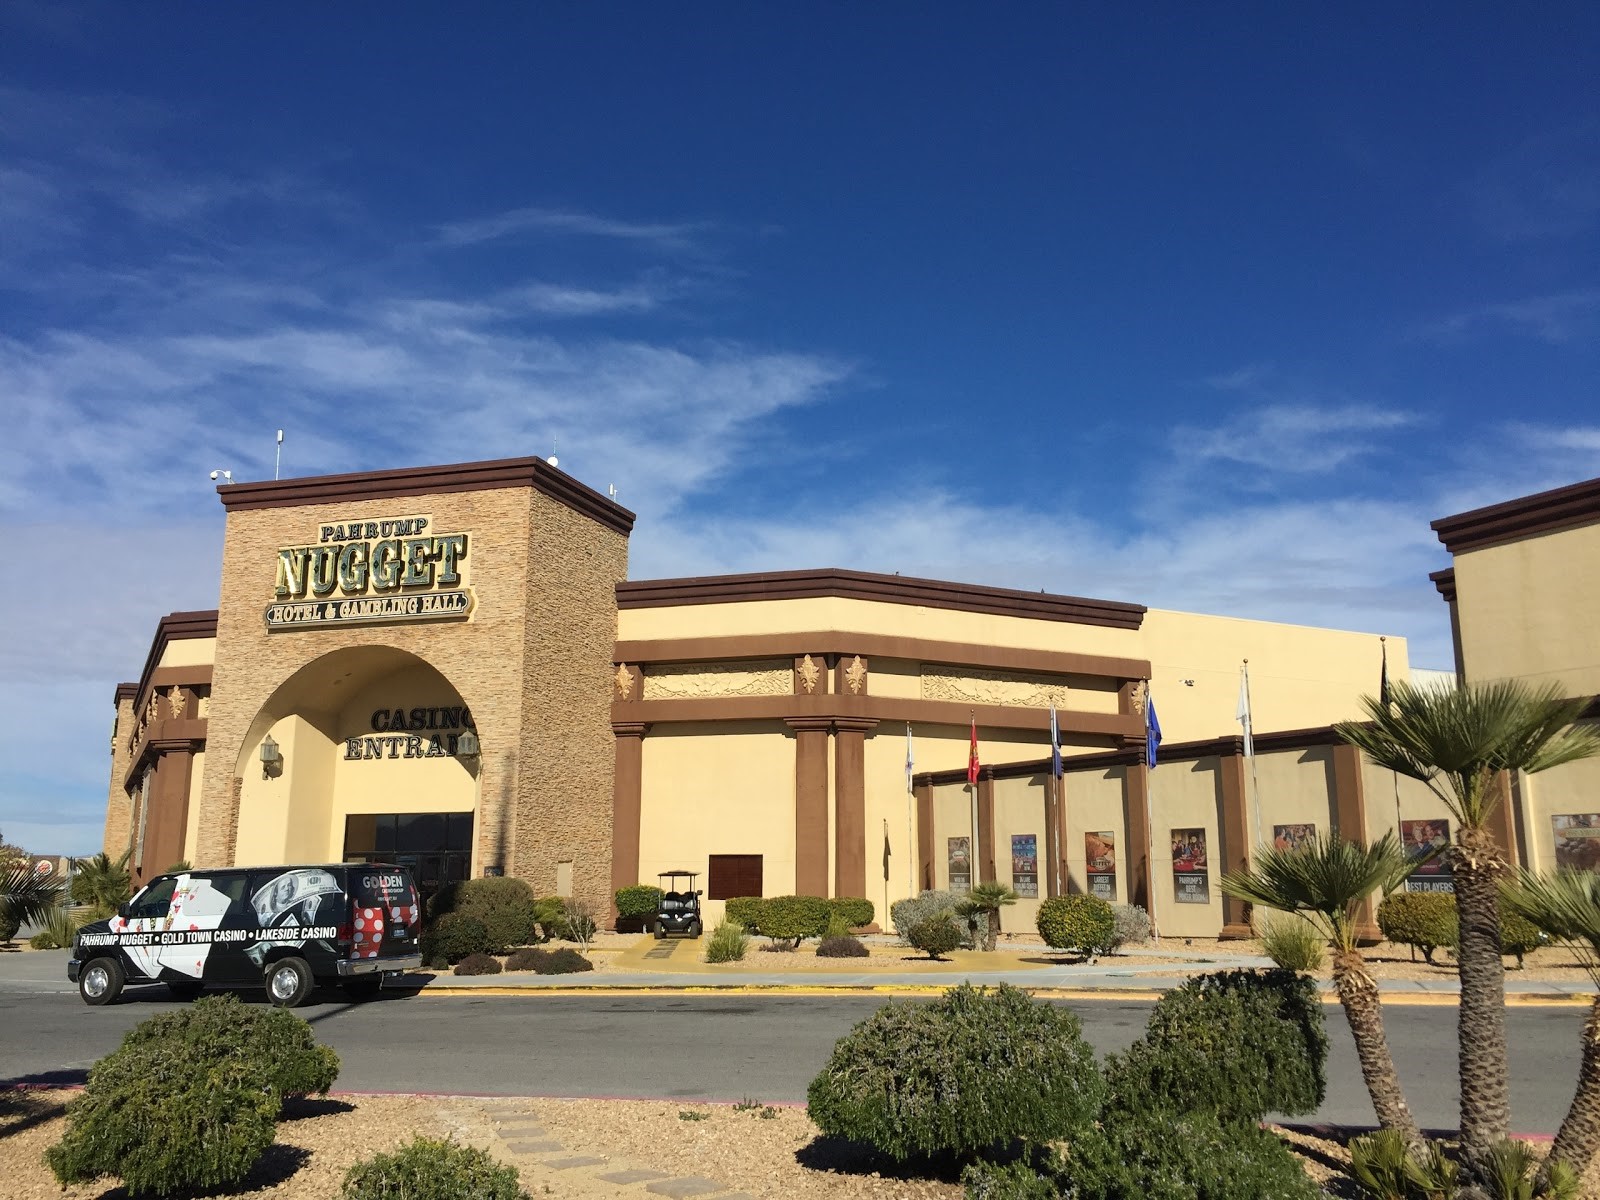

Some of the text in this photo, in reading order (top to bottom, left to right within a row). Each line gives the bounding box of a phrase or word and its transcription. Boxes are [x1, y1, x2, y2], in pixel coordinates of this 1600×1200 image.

[320, 518, 428, 542] PAHRUMP
[275, 534, 469, 597] NUGGET
[273, 593, 462, 623] HOTEL & GAMBLING HALL
[362, 875, 403, 888] GOLDEN
[1424, 882, 1454, 893] PLAYERS
[80, 926, 337, 946] PAHRUMP NUGGET GOLD TOWN CASINO LAKESIDE CASINO
